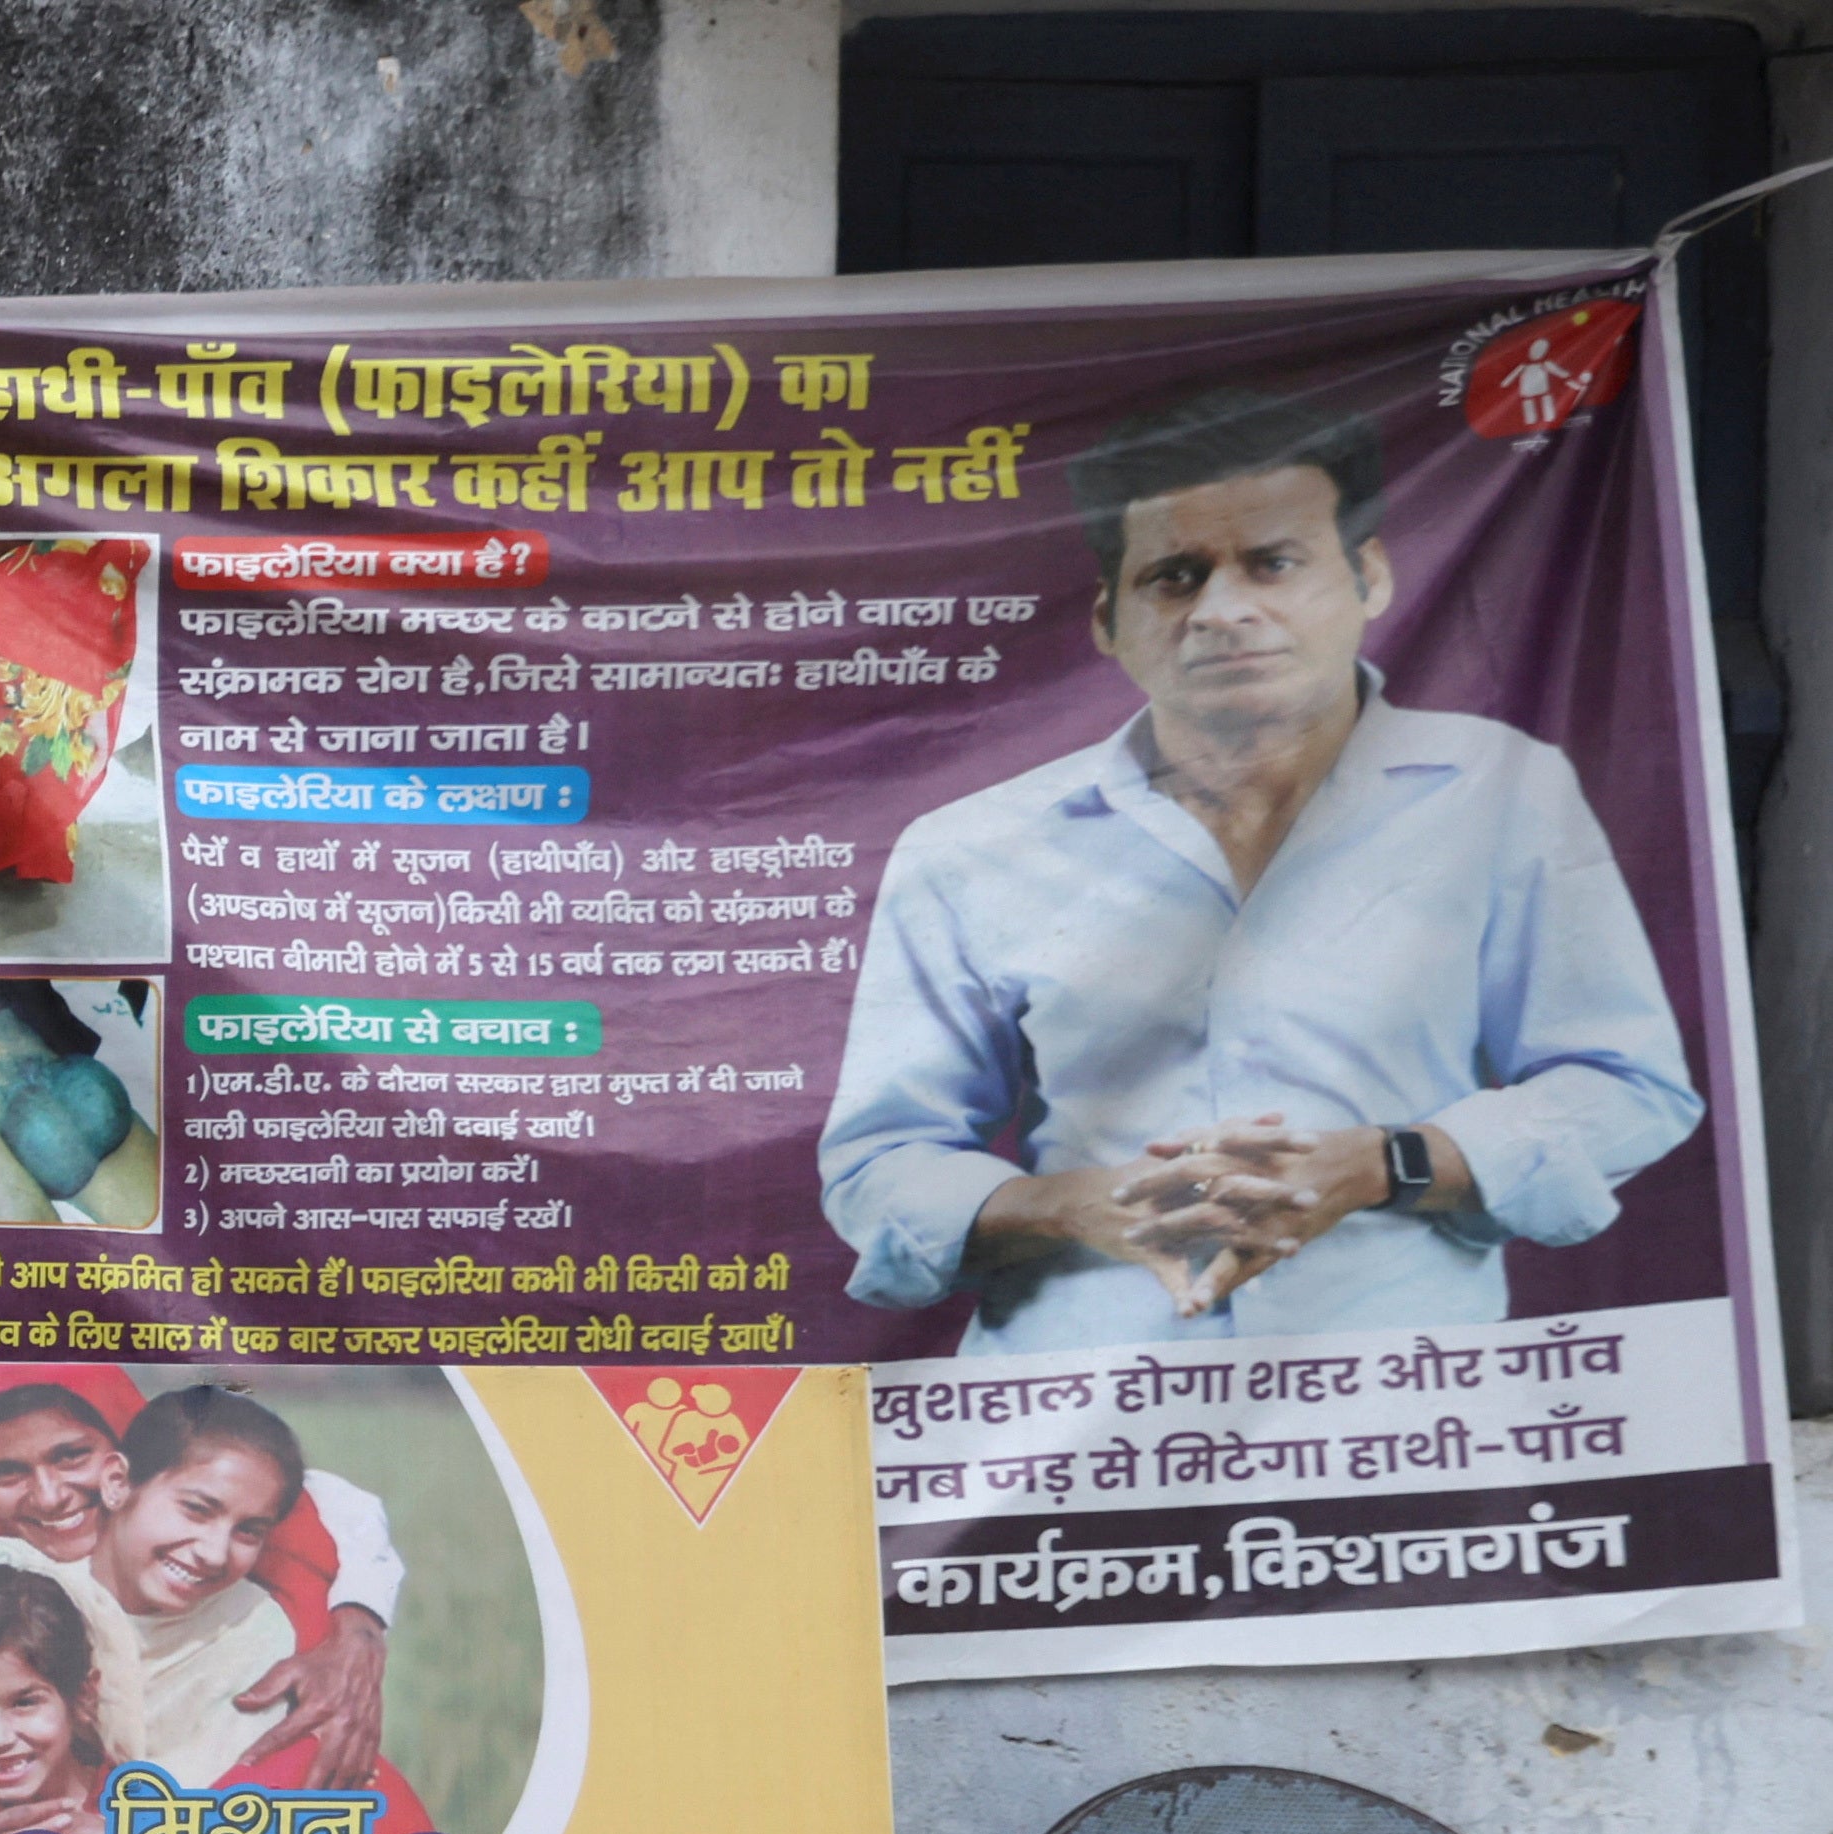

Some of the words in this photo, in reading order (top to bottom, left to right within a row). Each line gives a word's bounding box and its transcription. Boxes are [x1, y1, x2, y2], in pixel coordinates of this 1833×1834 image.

[319, 343, 749, 438] (फाइलेरिया)
[774, 354, 873, 410] का
[215, 440, 431, 512] शिकार
[450, 430, 603, 513] कहीं
[617, 449, 775, 512] आप
[789, 428, 874, 509] तो
[892, 422, 1031, 503] नहीं
[180, 541, 380, 582] फाइलेरिया
[388, 550, 465, 577] क्या
[473, 537, 532, 578] है?
[178, 597, 390, 640] फाइलेरिया
[400, 607, 517, 635] मच्छर
[523, 597, 575, 634] के
[580, 595, 701, 636] काटने
[712, 593, 753, 630] से
[764, 591, 846, 631] होने
[856, 597, 957, 626] वाला
[966, 595, 1039, 625] एक
[183, 773, 375, 810] फाइलेरिया
[383, 775, 428, 810] के
[437, 784, 547, 822] लक्षण
[198, 1004, 394, 1045] फाइलेरिया
[402, 1009, 441, 1043] से
[450, 1019, 552, 1044] बचाव
[872, 1373, 1094, 1431] खुशहाल
[1109, 1361, 1236, 1413] होगा
[1248, 1357, 1361, 1403] शहर
[1379, 1337, 1485, 1392] और
[1494, 1324, 1625, 1384] गाँव
[876, 1462, 968, 1503] जब
[980, 1451, 1078, 1505] जड़
[1088, 1438, 1141, 1490] से
[1153, 1433, 1328, 1486] मिटेगा
[1339, 1405, 1629, 1482] हाथी-पाँव
